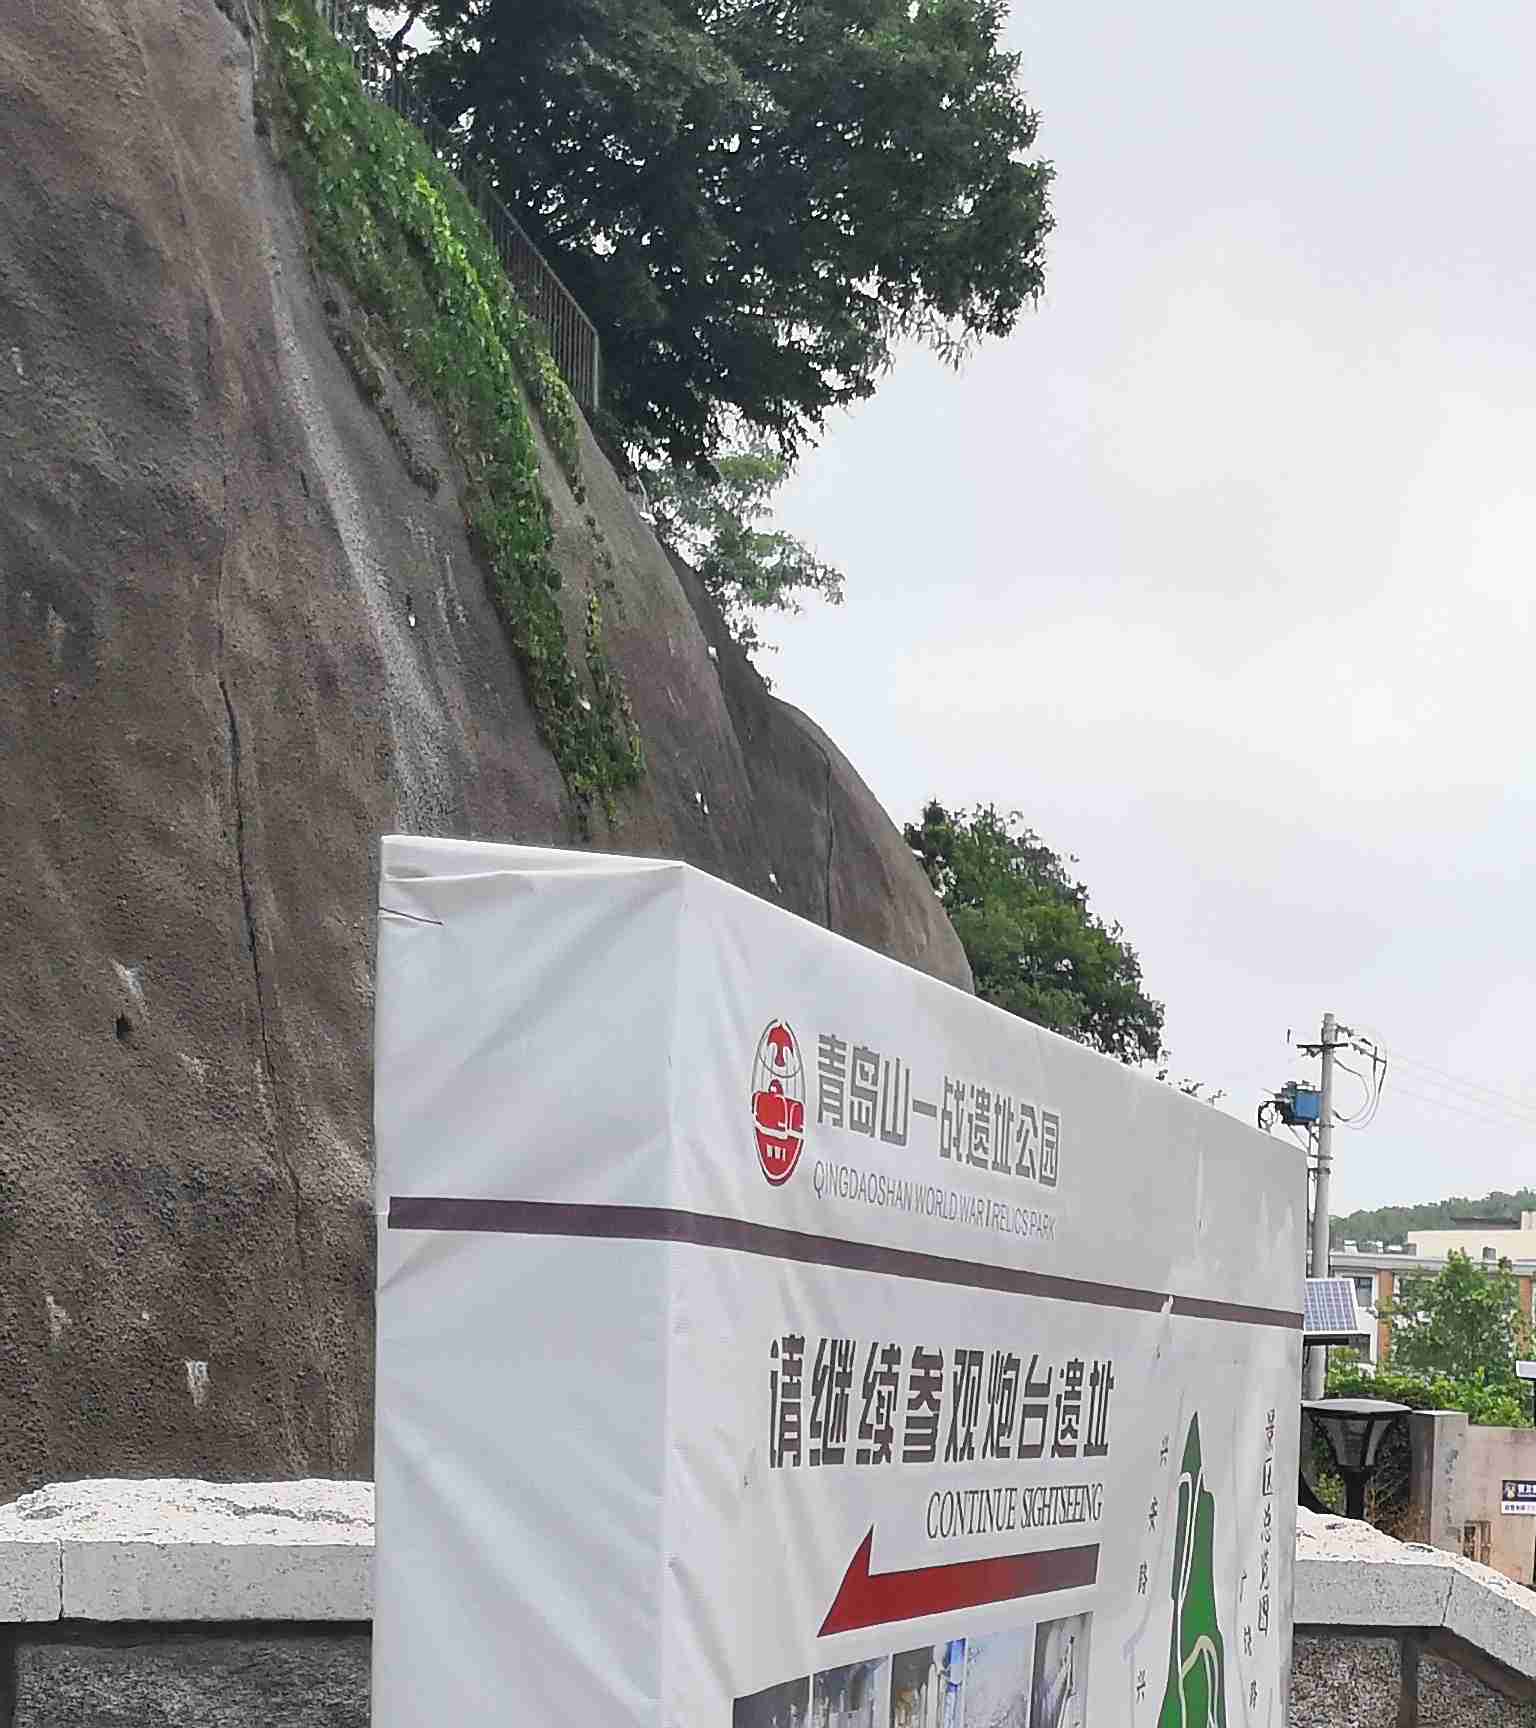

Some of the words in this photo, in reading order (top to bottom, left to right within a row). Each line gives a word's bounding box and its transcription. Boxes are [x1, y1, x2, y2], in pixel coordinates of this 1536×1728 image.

[816, 1033, 1060, 1187] 青岛山一战遗址公园
[814, 1161, 912, 1212] QINGDAOSHAN
[915, 1184, 957, 1221] WORLD
[769, 1334, 1115, 1468] 请继续参观炮台遗址
[926, 1487, 1018, 1539] CONTINUE
[1020, 1482, 1104, 1529] SIGHTSEEING
